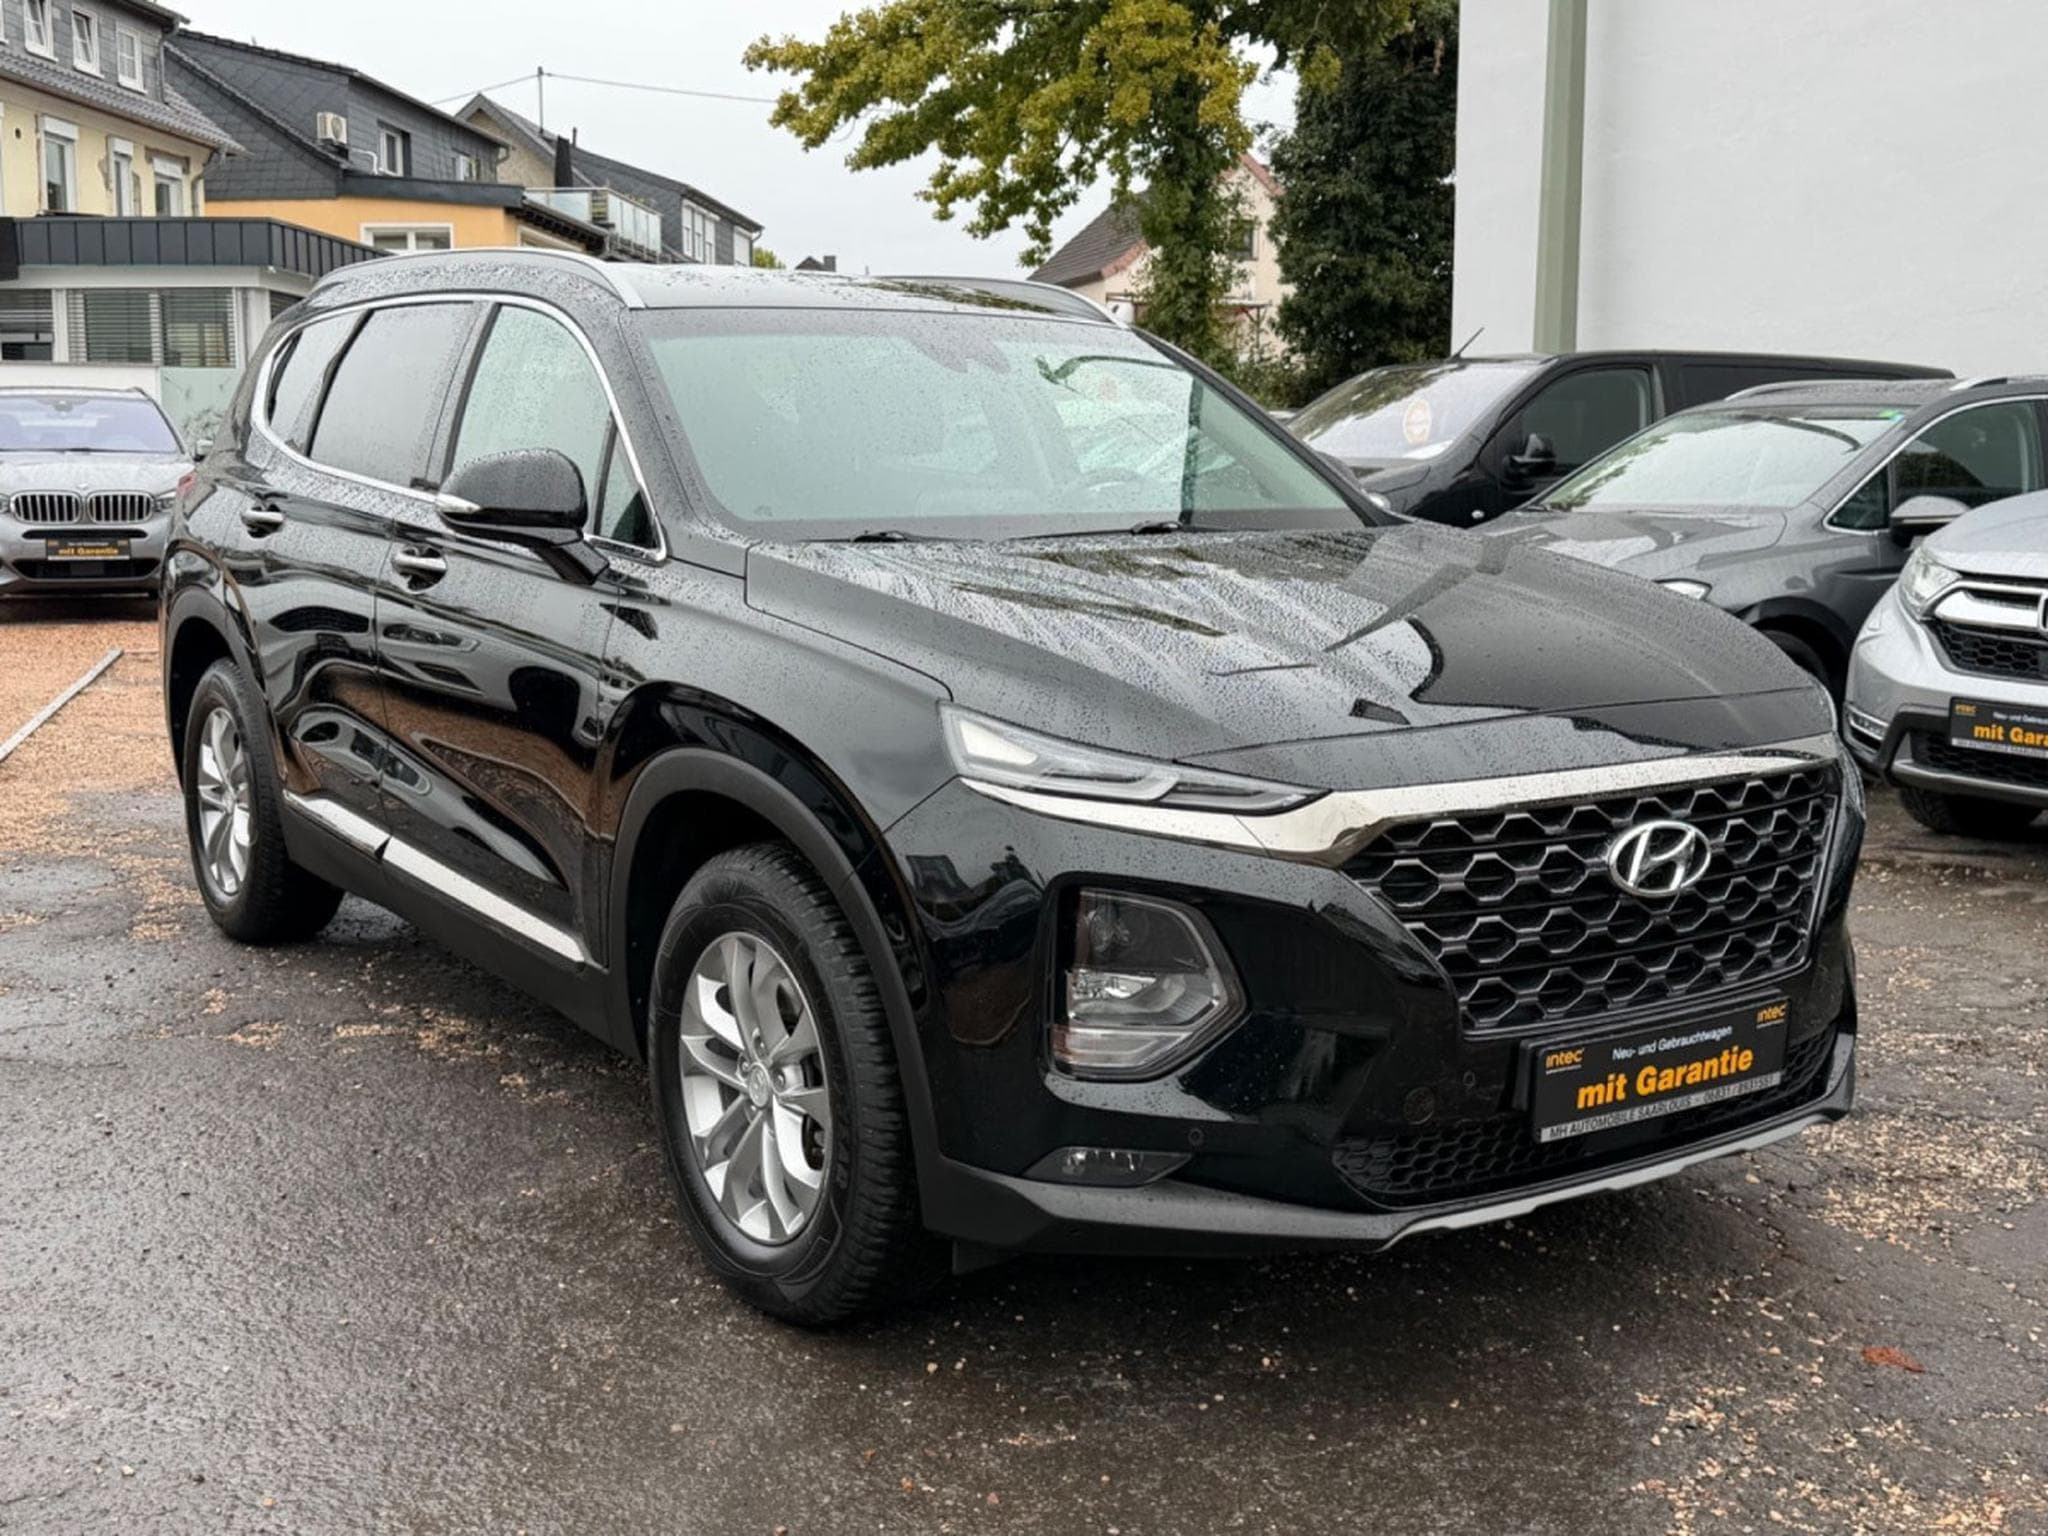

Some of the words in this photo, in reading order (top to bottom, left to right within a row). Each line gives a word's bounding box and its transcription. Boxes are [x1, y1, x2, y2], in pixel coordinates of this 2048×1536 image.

[1974, 724, 2005, 741] mit
[1638, 1040, 1657, 1056] und
[1658, 1025, 1733, 1051] Gebrauchtwagen
[1577, 1073, 1627, 1110] mit
[1636, 1045, 1754, 1096] Garantie
